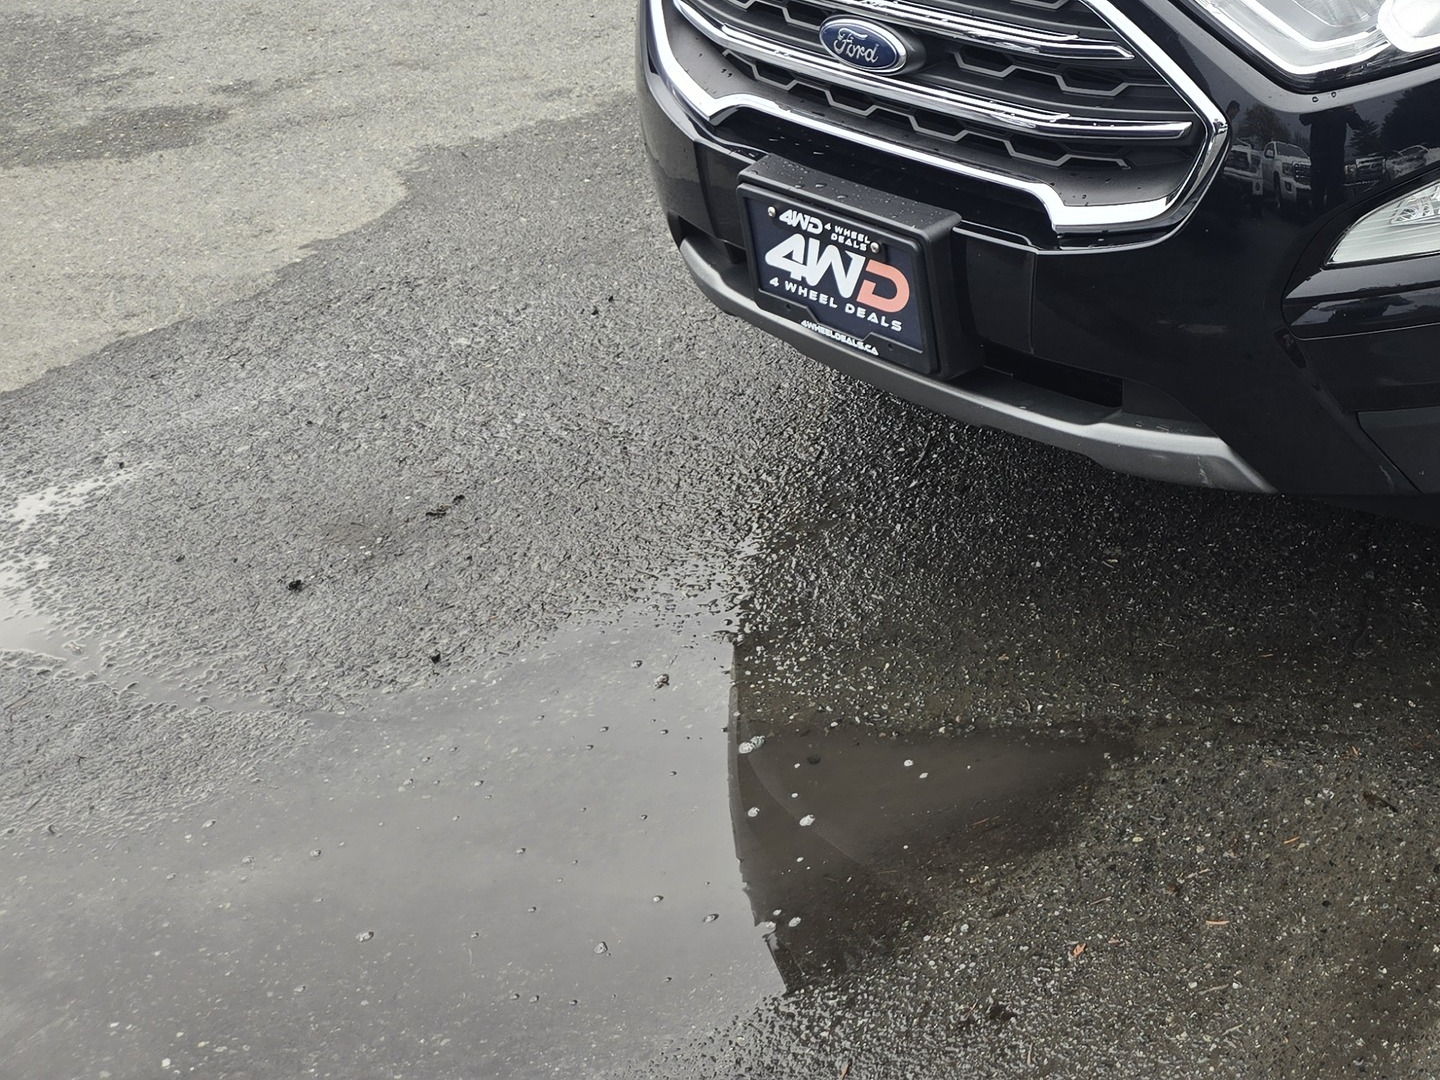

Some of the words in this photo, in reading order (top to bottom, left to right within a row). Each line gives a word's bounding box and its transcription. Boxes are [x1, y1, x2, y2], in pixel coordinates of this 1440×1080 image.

[833, 27, 880, 63] Ford
[779, 208, 823, 235] 4WD
[824, 222, 832, 231] 4
[834, 225, 871, 244] WHEEL
[830, 233, 868, 252] DEALS
[765, 233, 910, 313] 4WD
[769, 277, 780, 287] 4
[785, 280, 838, 308] WHEEL
[845, 304, 902, 332] DEALS
[800, 319, 879, 356] 4WHEELDEALS.CA
